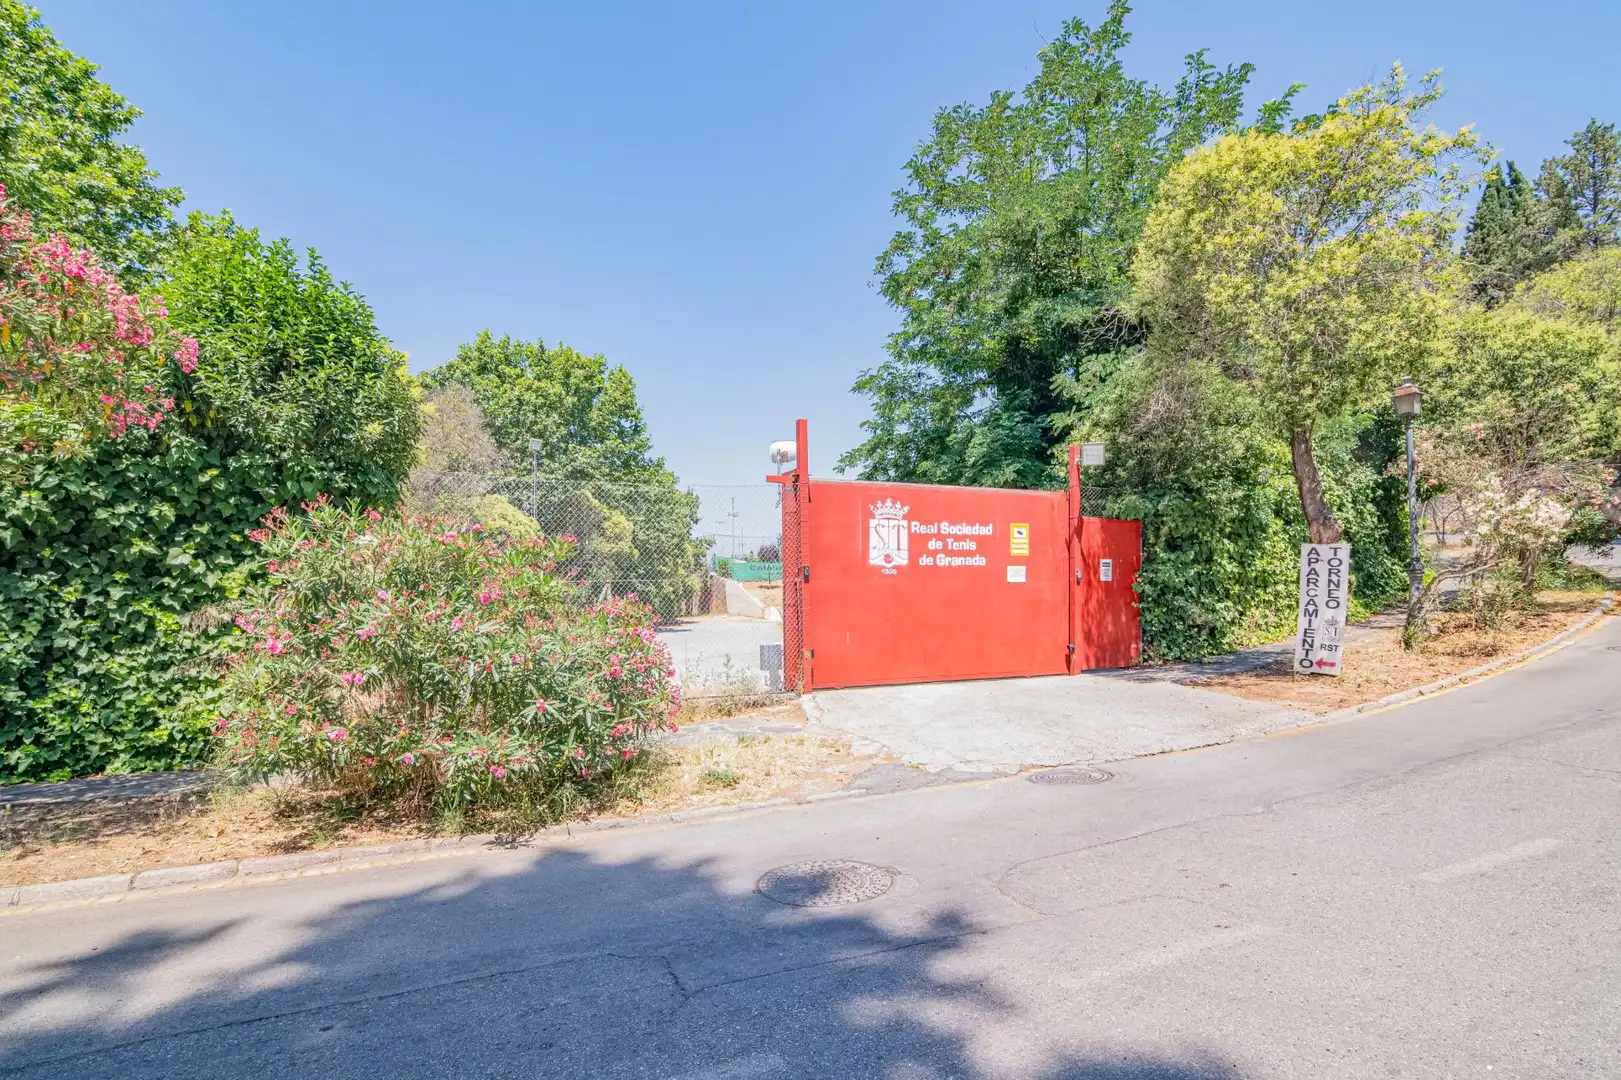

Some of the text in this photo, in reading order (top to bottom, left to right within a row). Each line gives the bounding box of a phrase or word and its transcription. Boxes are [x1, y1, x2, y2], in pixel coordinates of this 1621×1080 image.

[911, 521, 993, 535] Real Sociedad
[928, 537, 976, 551] de Tenis
[919, 553, 986, 567] de Granada
[1325, 547, 1343, 610] TORNEO
[1299, 547, 1321, 669] APARCAMIENTO
[1320, 643, 1340, 653] RST
